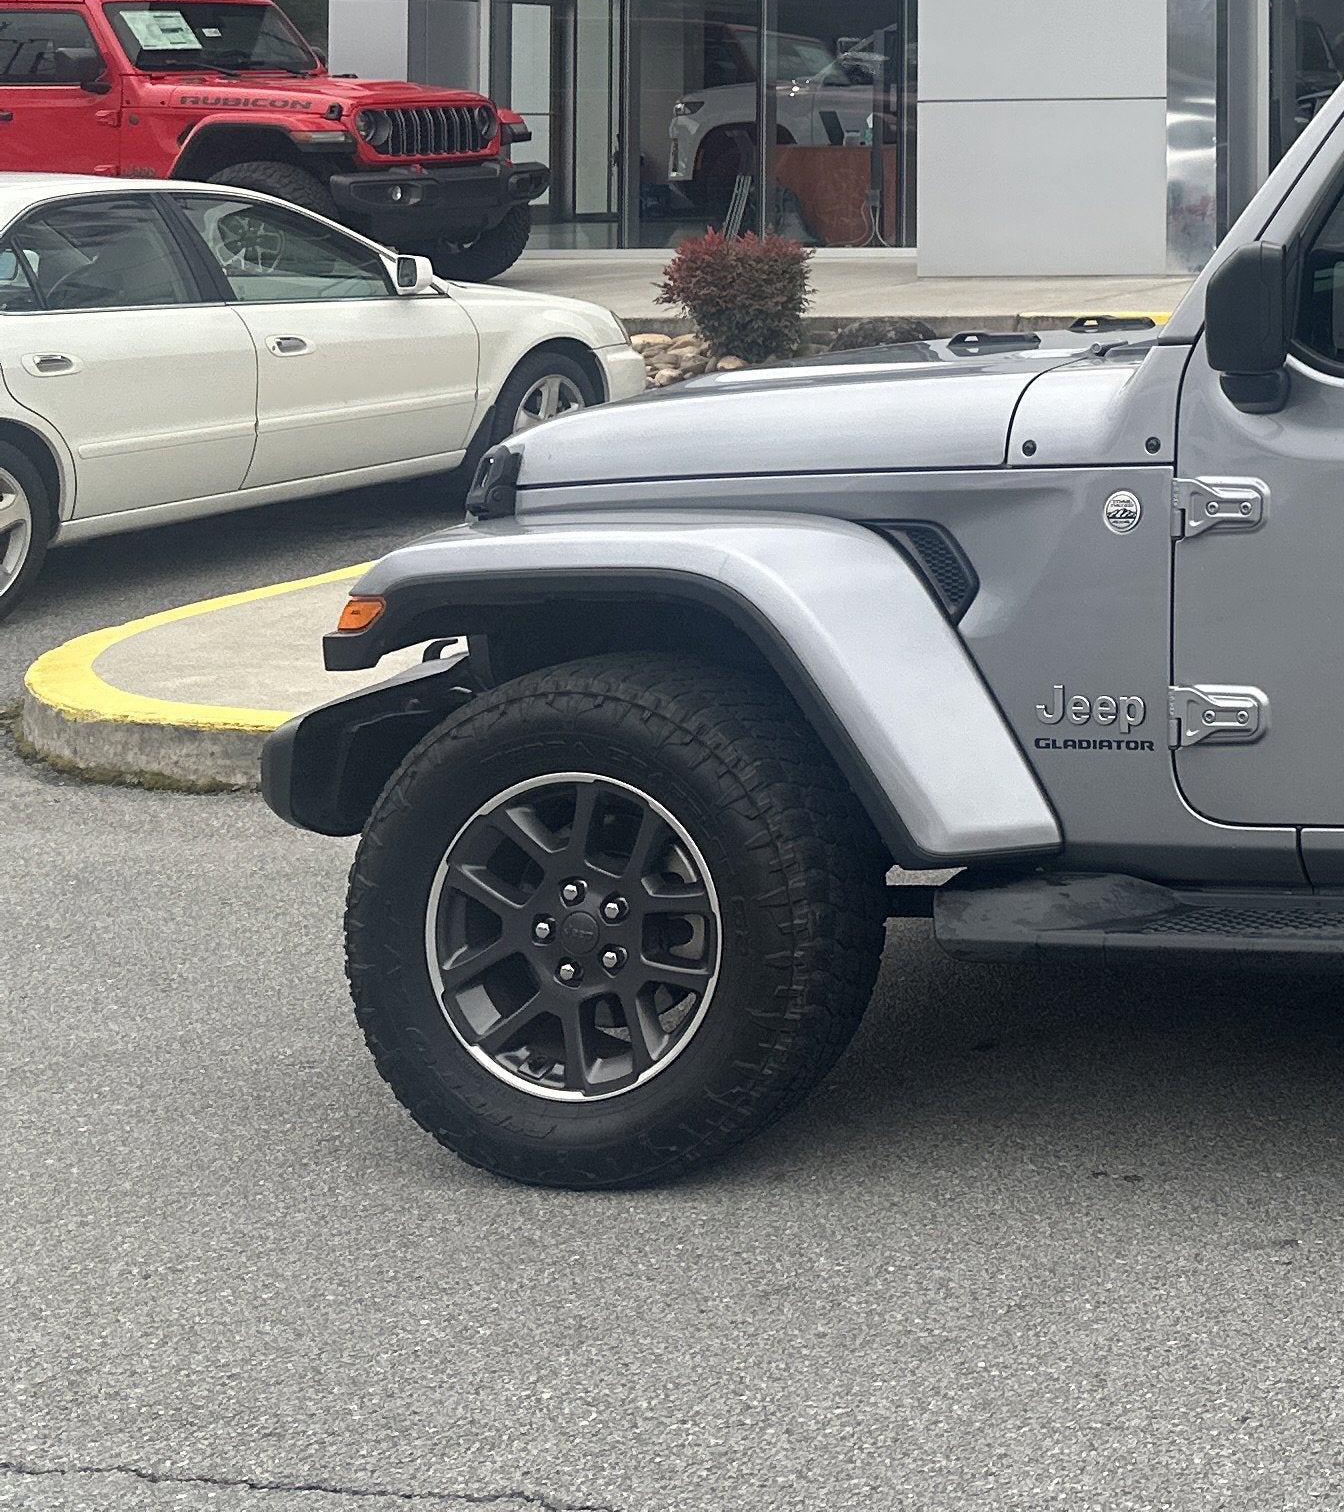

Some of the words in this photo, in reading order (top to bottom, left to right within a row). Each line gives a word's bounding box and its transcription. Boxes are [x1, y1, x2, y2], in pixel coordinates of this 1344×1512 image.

[179, 95, 312, 109] RUBICON
[1036, 684, 1147, 734] Jeep
[1034, 737, 1155, 751] GLADIATOR
